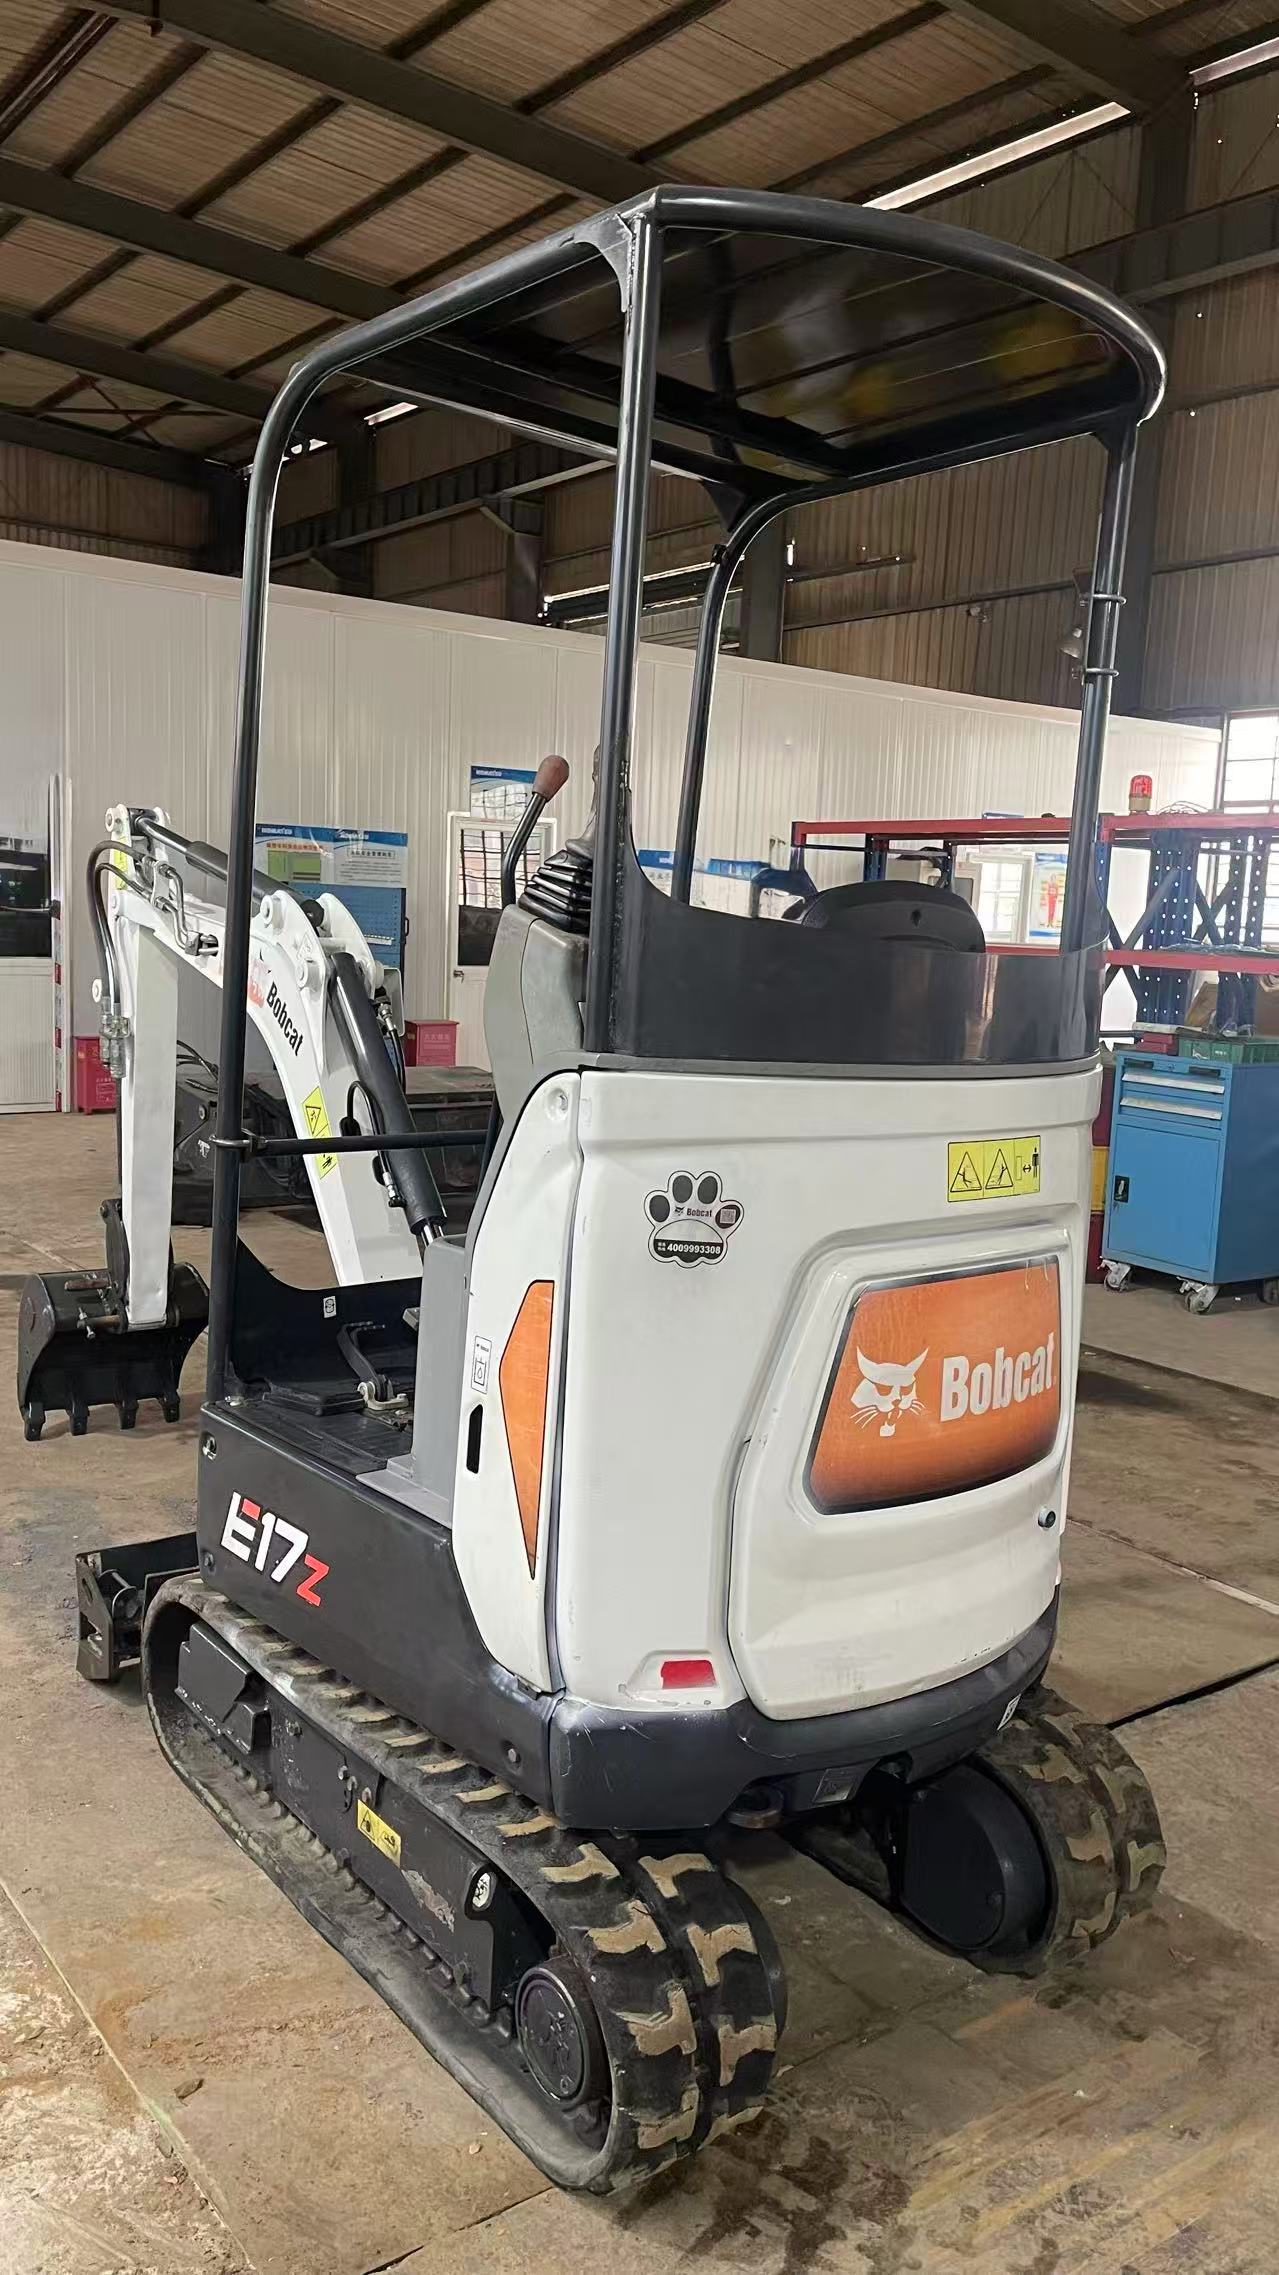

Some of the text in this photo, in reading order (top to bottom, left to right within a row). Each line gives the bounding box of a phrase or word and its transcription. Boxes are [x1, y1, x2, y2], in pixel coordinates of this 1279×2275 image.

[266, 981, 304, 1057] Bobcat
[686, 1207, 712, 1218] Bobcat
[667, 1243, 721, 1255] 4009993308
[940, 1331, 1055, 1422] Bobcat
